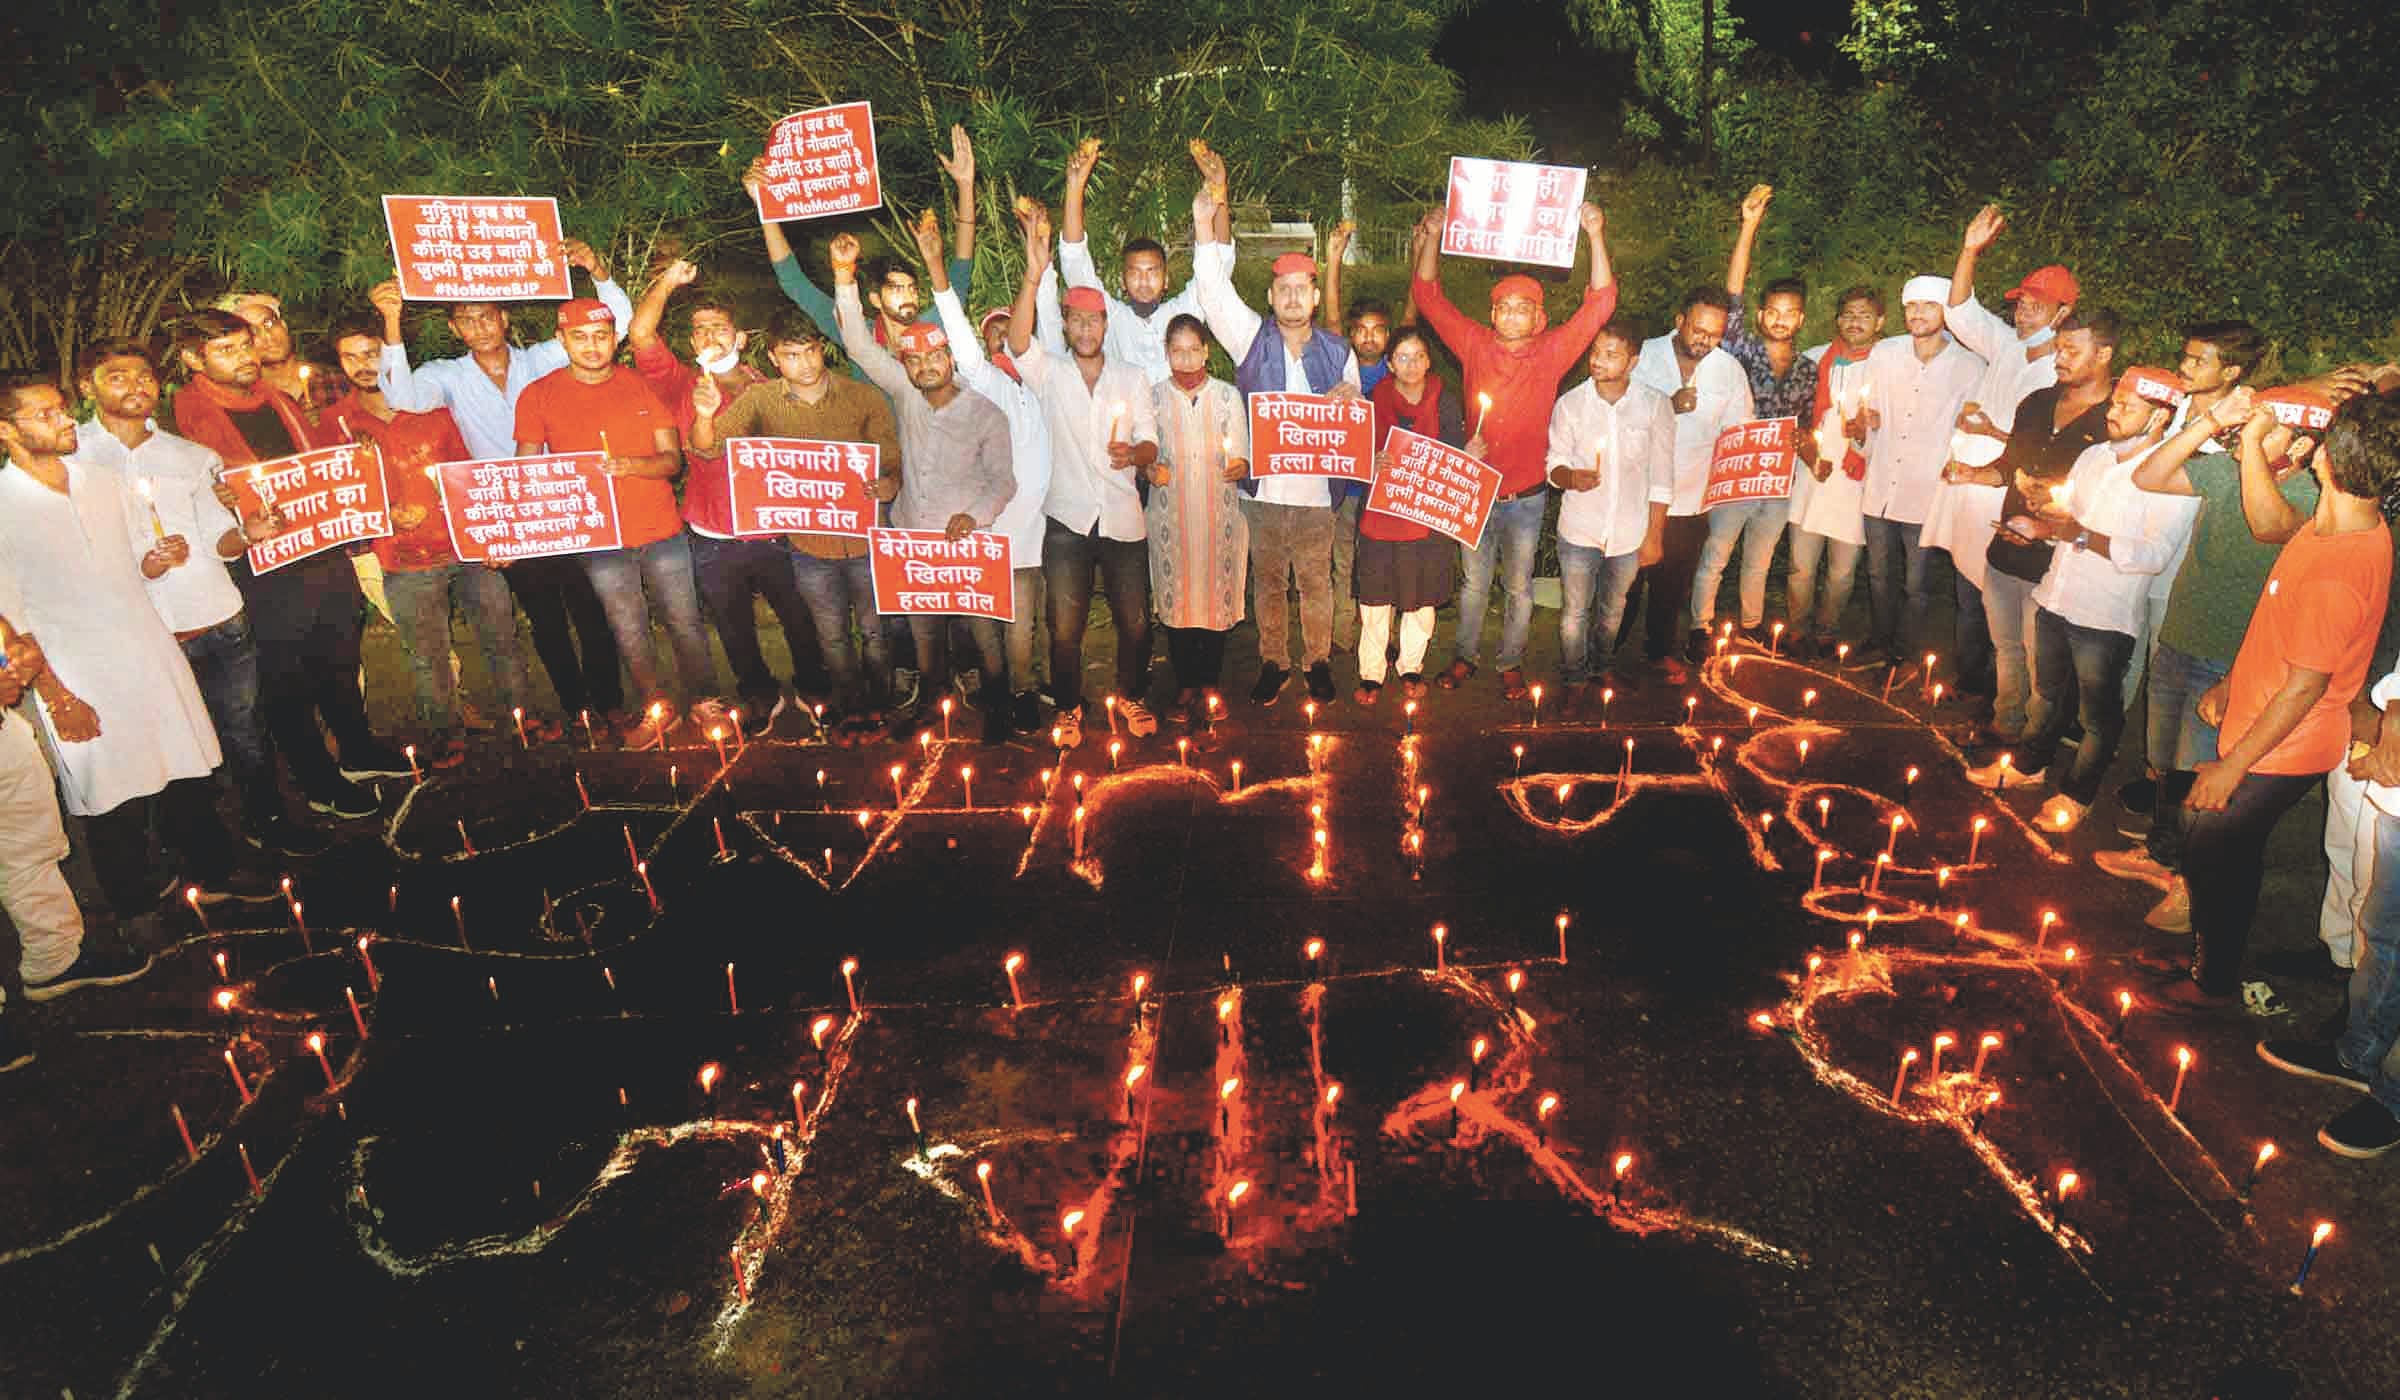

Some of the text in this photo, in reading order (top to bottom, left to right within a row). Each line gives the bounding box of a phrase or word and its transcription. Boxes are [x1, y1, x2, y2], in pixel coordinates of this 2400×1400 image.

[805, 117, 824, 131] जब
[854, 168, 870, 184] की
[472, 205, 498, 219] जब
[786, 194, 861, 215] #NoMoreBJP
[415, 220, 453, 240] जाती
[496, 241, 531, 259] जाती
[533, 259, 554, 276] की
[435, 282, 539, 296] #NoMoreBJP
[1256, 394, 1368, 424] बेरोजगारी के
[1278, 421, 1347, 447] खिलाफ
[311, 450, 361, 480] नहीं,
[737, 441, 871, 474] बेरोजगारी के
[1269, 448, 1357, 473] हल्ला बोल
[1447, 453, 1464, 469] जब
[1759, 451, 1784, 469] का
[522, 464, 548, 479] जब
[467, 480, 504, 500] जाती
[764, 470, 846, 500] खिलाफ
[1739, 470, 1788, 495] चाहिए
[333, 483, 367, 506] का
[548, 496, 582, 513] जाती
[318, 509, 384, 540] चाहिए
[583, 512, 605, 528] की
[754, 502, 858, 529] हल्ला बोल
[1390, 501, 1461, 534] #NoMoreBJP
[1464, 512, 1478, 529] की
[488, 534, 591, 556] #NoMoreBJP
[877, 531, 1003, 560] बेरोजगारी के
[904, 559, 984, 584] खिलाफ
[896, 585, 995, 611] हल्ला बोल
